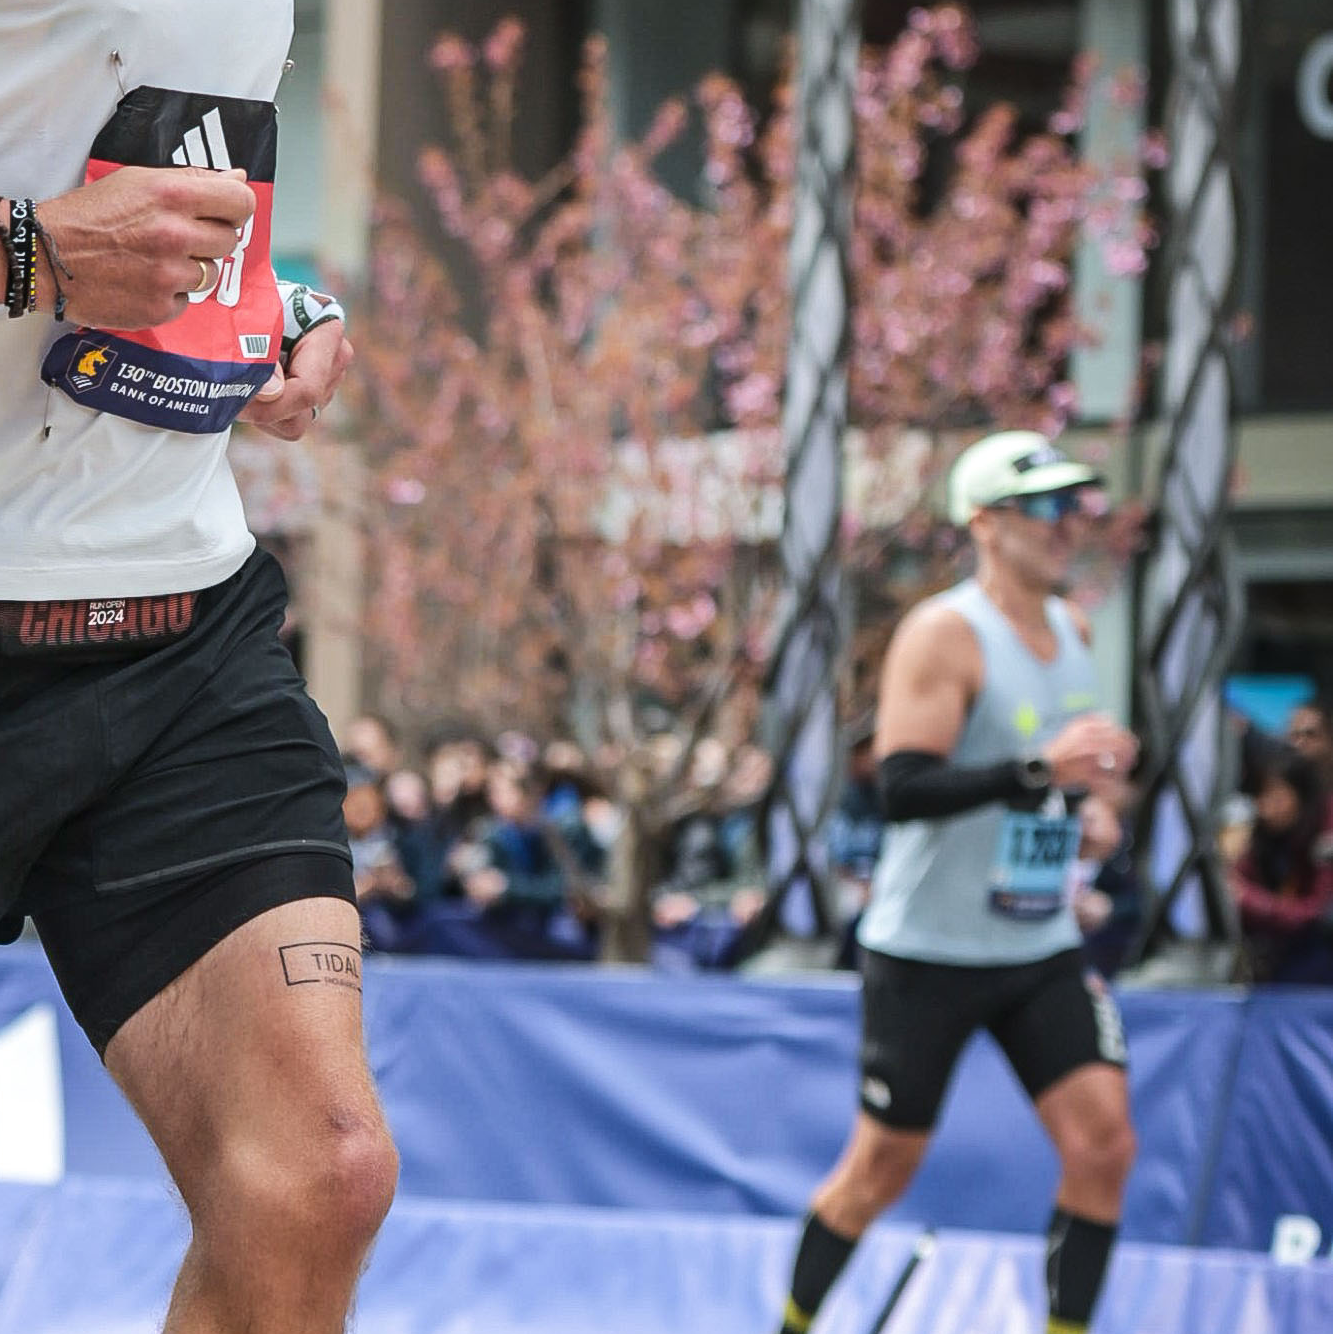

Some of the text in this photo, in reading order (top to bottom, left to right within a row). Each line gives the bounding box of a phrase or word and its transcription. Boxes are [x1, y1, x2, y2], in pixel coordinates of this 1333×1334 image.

[117, 363, 157, 383] 130TH
[152, 374, 209, 399] BOSTON
[110, 382, 210, 415] BANK OF AMERICA
[88, 609, 125, 626] 2024
[311, 953, 360, 979] TIDAL
